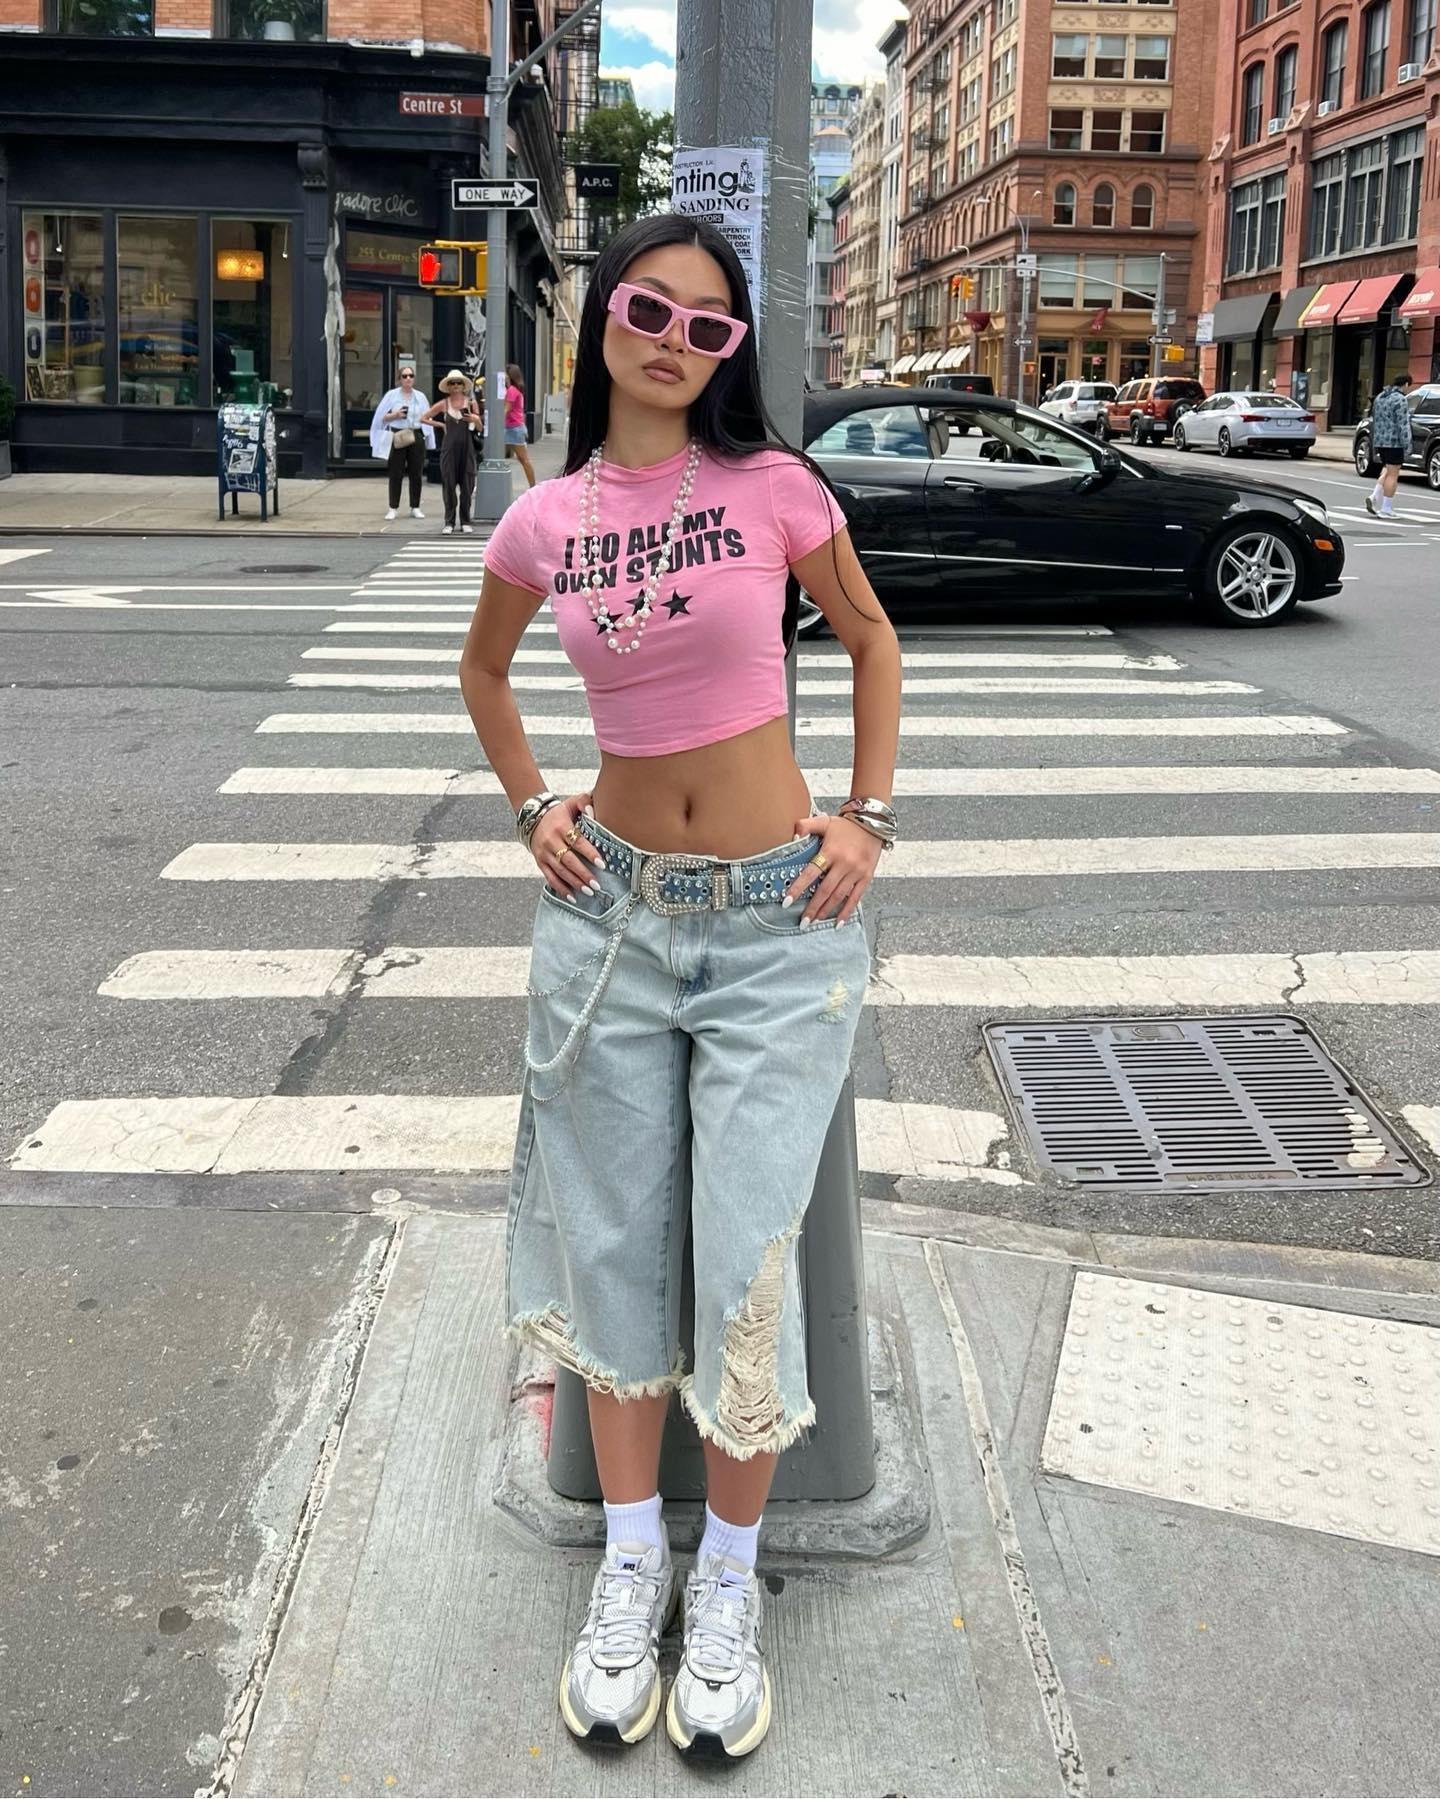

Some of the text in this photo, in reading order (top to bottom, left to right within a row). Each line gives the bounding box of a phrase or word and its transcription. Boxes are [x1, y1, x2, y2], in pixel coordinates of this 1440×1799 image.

[402, 97, 462, 114] Centre St
[582, 177, 613, 188] A.P.C.
[465, 189, 526, 200] ONE WAY
[679, 197, 750, 214] SANDING
[565, 537, 575, 569] I
[581, 532, 620, 568] DO
[682, 506, 726, 536] MY
[554, 528, 746, 595] OWN STUNTS
